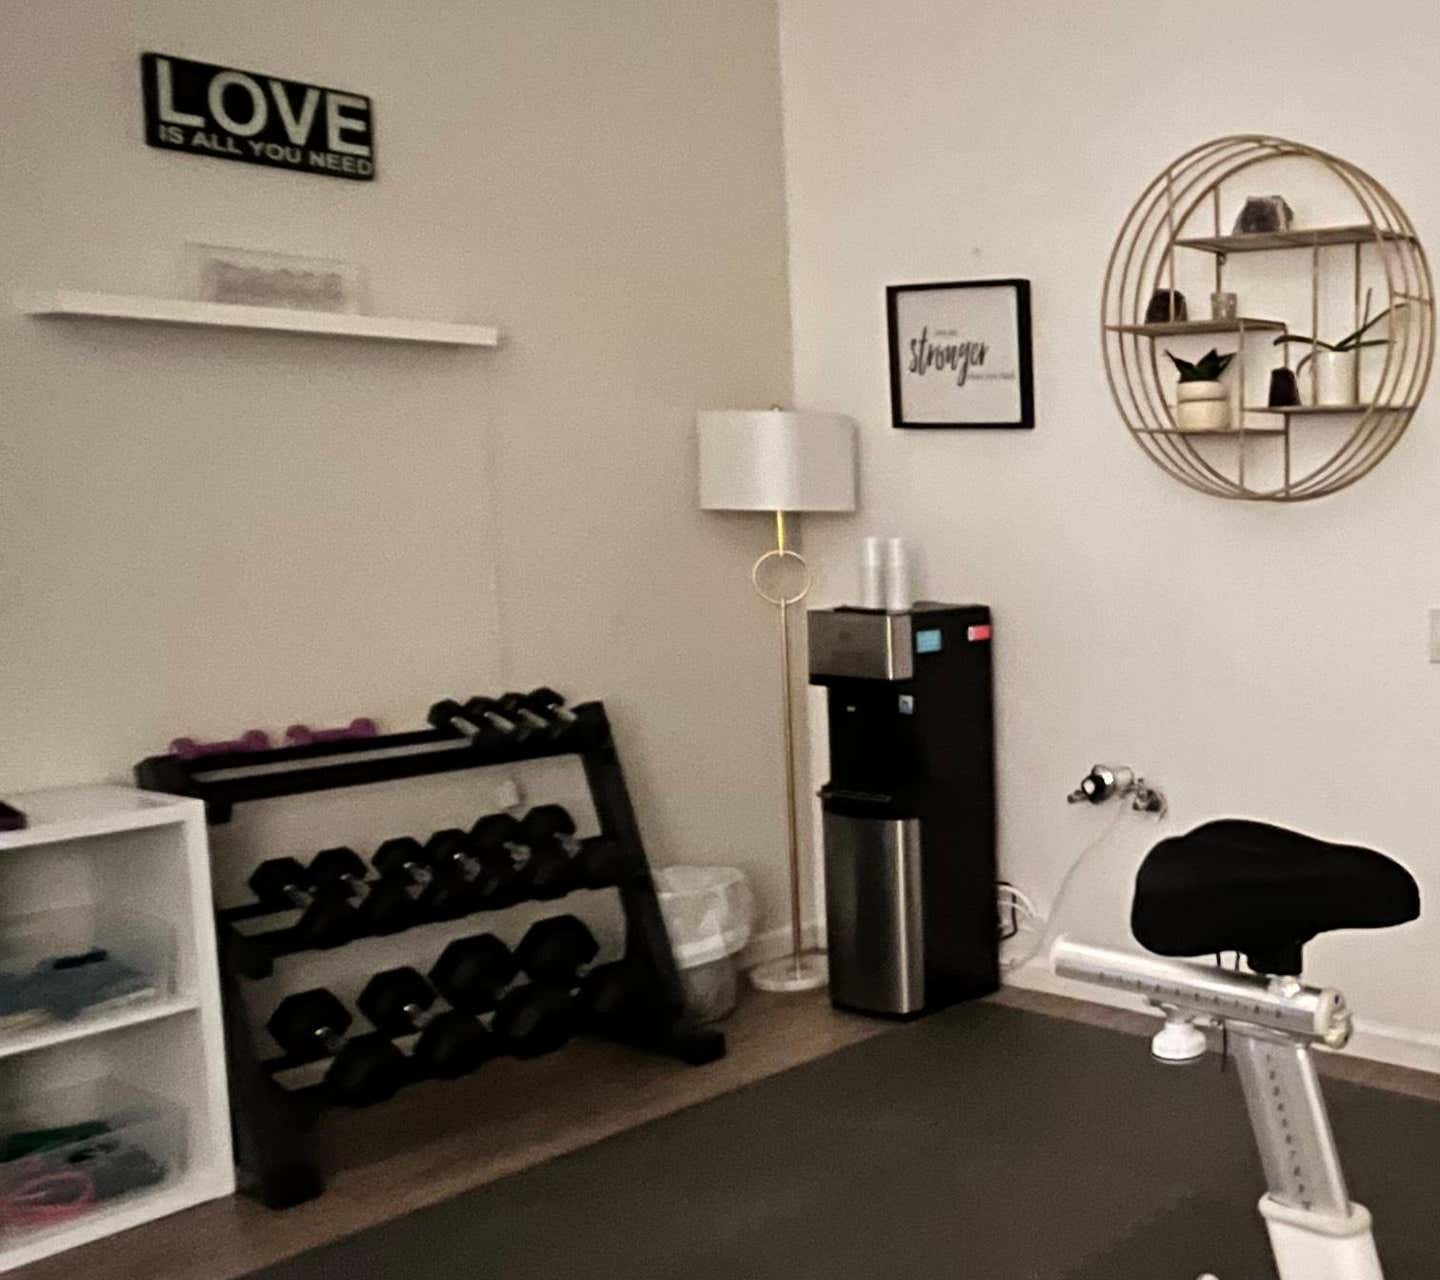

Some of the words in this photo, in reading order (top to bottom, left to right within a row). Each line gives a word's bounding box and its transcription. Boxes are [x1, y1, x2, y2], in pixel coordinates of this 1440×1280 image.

[156, 58, 371, 156] LOVE
[158, 124, 184, 145] IS
[191, 131, 242, 155] ALL
[249, 139, 302, 164] YOU
[309, 152, 374, 176] NEED
